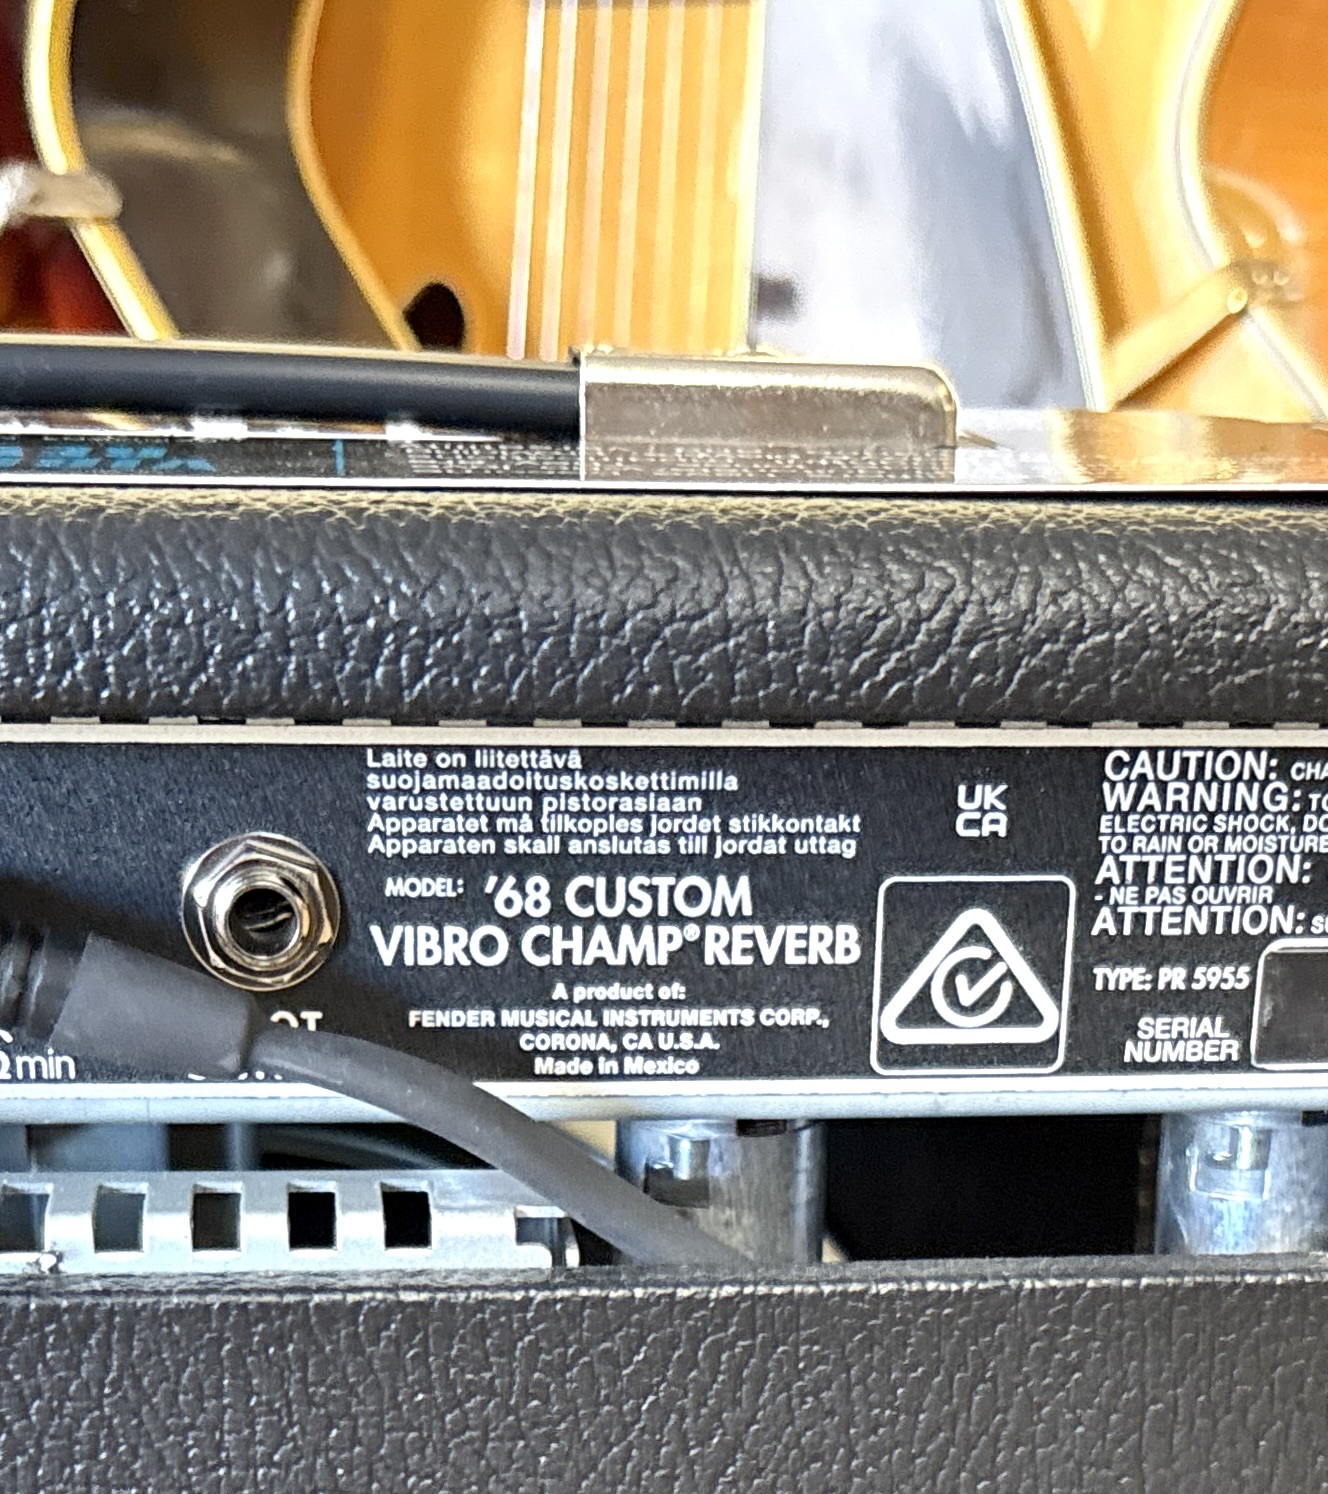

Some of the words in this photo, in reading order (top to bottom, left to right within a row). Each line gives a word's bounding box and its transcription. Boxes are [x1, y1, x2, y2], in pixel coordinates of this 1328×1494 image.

[366, 748, 428, 770] Laite
[435, 748, 466, 770] on
[474, 748, 582, 770] liitettävä
[1104, 750, 1279, 782] CAUTION:
[366, 770, 739, 794] suojamaadoituskoskettimilla
[366, 794, 532, 813] varustettuun
[542, 794, 702, 818] pistorasiaan
[957, 784, 1009, 811] UK
[1102, 782, 1301, 813] WARNING:
[366, 814, 489, 837] Apparatet
[496, 814, 533, 837] må
[541, 814, 644, 837] tilkoples
[649, 814, 722, 837] jordet
[728, 814, 862, 837] stikkontakt
[955, 812, 1008, 838] CA
[1099, 815, 1208, 834] ELECTRIC
[1213, 815, 1296, 834] SHOCK,
[367, 836, 496, 859] Apparaten
[504, 836, 560, 859] skall
[568, 836, 671, 859] anslutas
[678, 836, 708, 859] till
[714, 836, 787, 859] jordat
[794, 836, 857, 859] uttag
[1099, 835, 1126, 855] TO
[1133, 835, 1182, 855] RAIN
[1188, 835, 1218, 855] OR
[1095, 855, 1311, 886] ATTENTION:
[385, 878, 465, 898] MODEL:
[565, 875, 753, 918] CUSTOM
[1109, 886, 1139, 904] NE
[1145, 886, 1186, 904] PAS
[1192, 886, 1273, 904] OUVRIR
[1091, 905, 1306, 936] ATTENTION:
[370, 925, 509, 967] VIBRO
[704, 925, 862, 966] REVERB
[1093, 967, 1152, 991] TYPE:
[1158, 967, 1188, 991] PR
[1193, 967, 1250, 991] 5955
[552, 984, 568, 1000] A
[574, 983, 654, 1004] product
[659, 983, 686, 1001] of:
[409, 1008, 496, 1028] FENDER
[501, 1008, 598, 1028] MUSICAL
[602, 1008, 755, 1028] INSTRUMENTS
[759, 1008, 830, 1028] CORP.,
[1137, 1017, 1227, 1040] SERIAL
[519, 1033, 617, 1053] CORONA,
[622, 1033, 654, 1053] CA
[658, 1033, 720, 1053] U.S.A.
[1123, 1040, 1240, 1064] NUMBER
[534, 1057, 593, 1076] Made
[599, 1057, 618, 1076] in
[623, 1057, 700, 1076] Mexico
